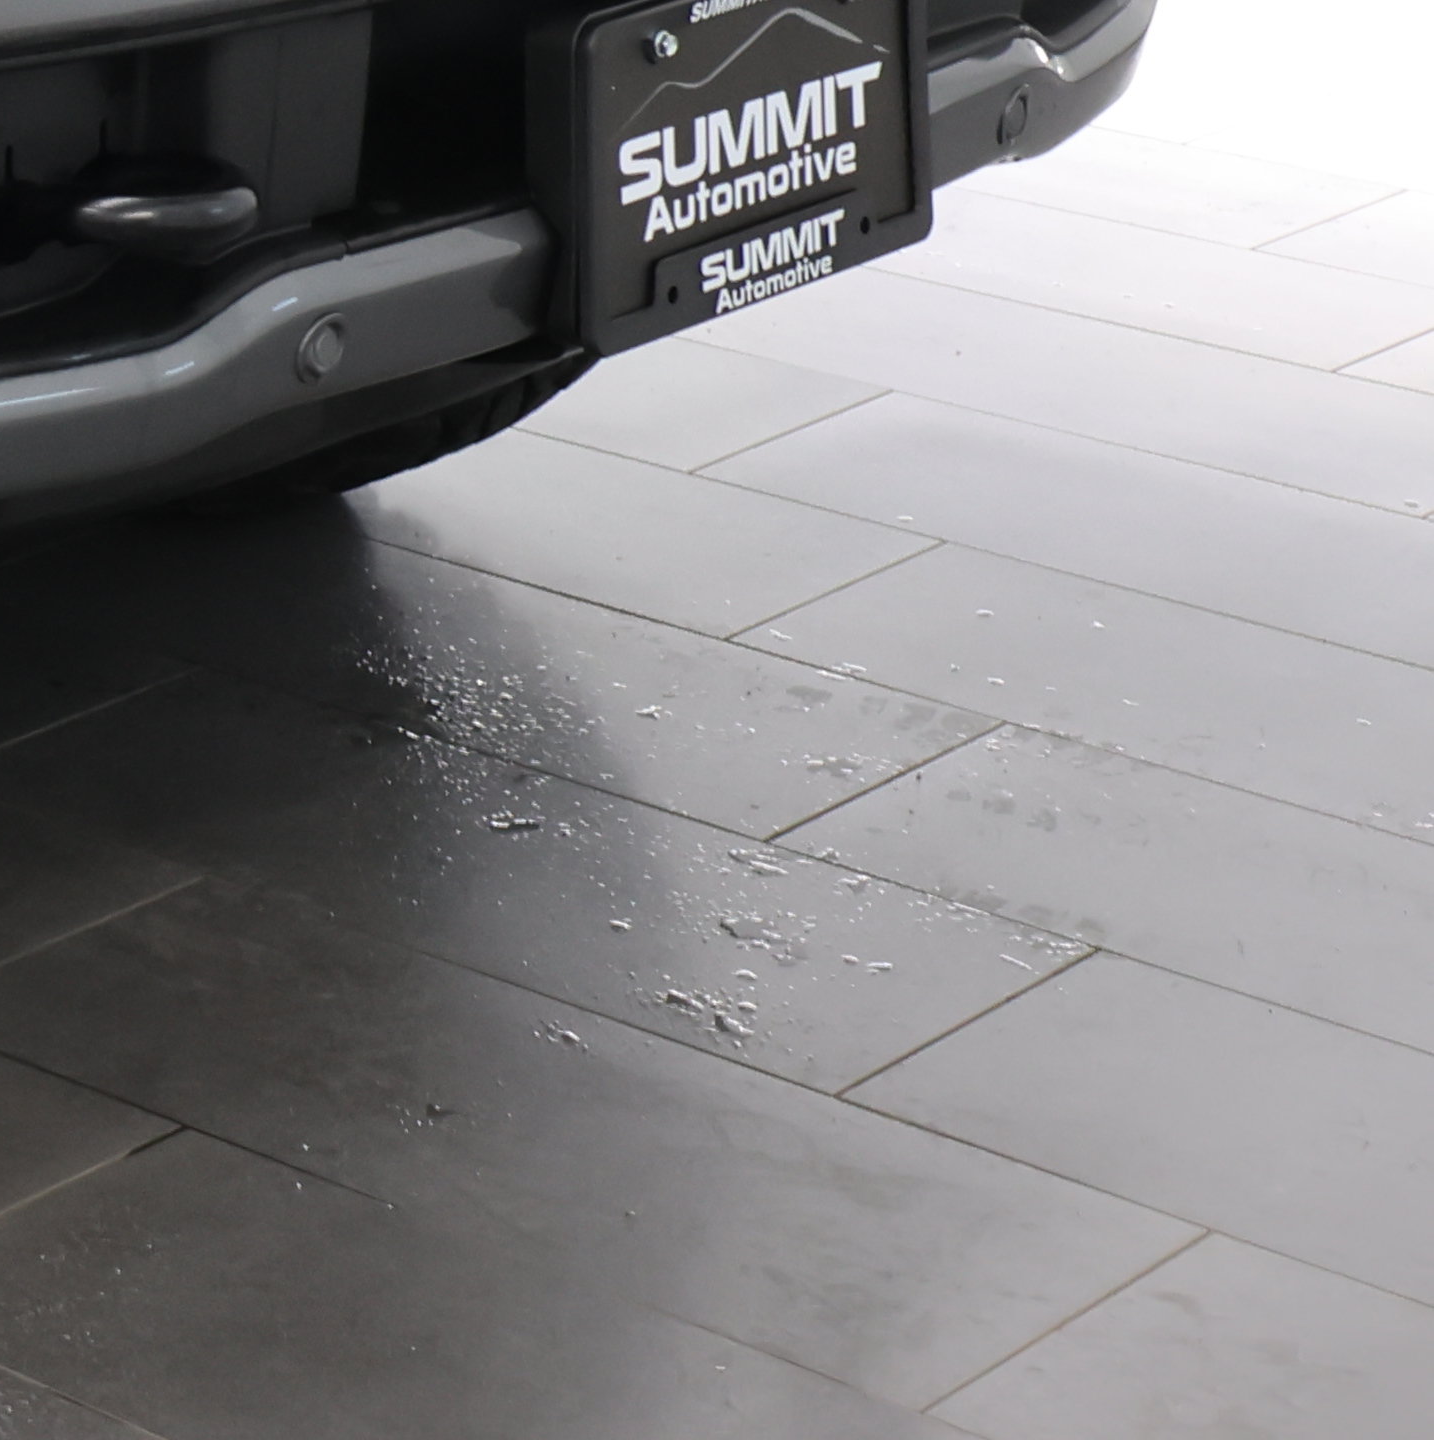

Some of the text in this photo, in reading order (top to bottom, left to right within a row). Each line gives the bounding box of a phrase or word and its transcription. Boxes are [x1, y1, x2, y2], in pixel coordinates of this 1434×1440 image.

[618, 60, 883, 206] SUMMIT
[643, 140, 857, 243] Automotive
[700, 208, 846, 293] SUMMIT
[714, 251, 833, 314] Automotive
